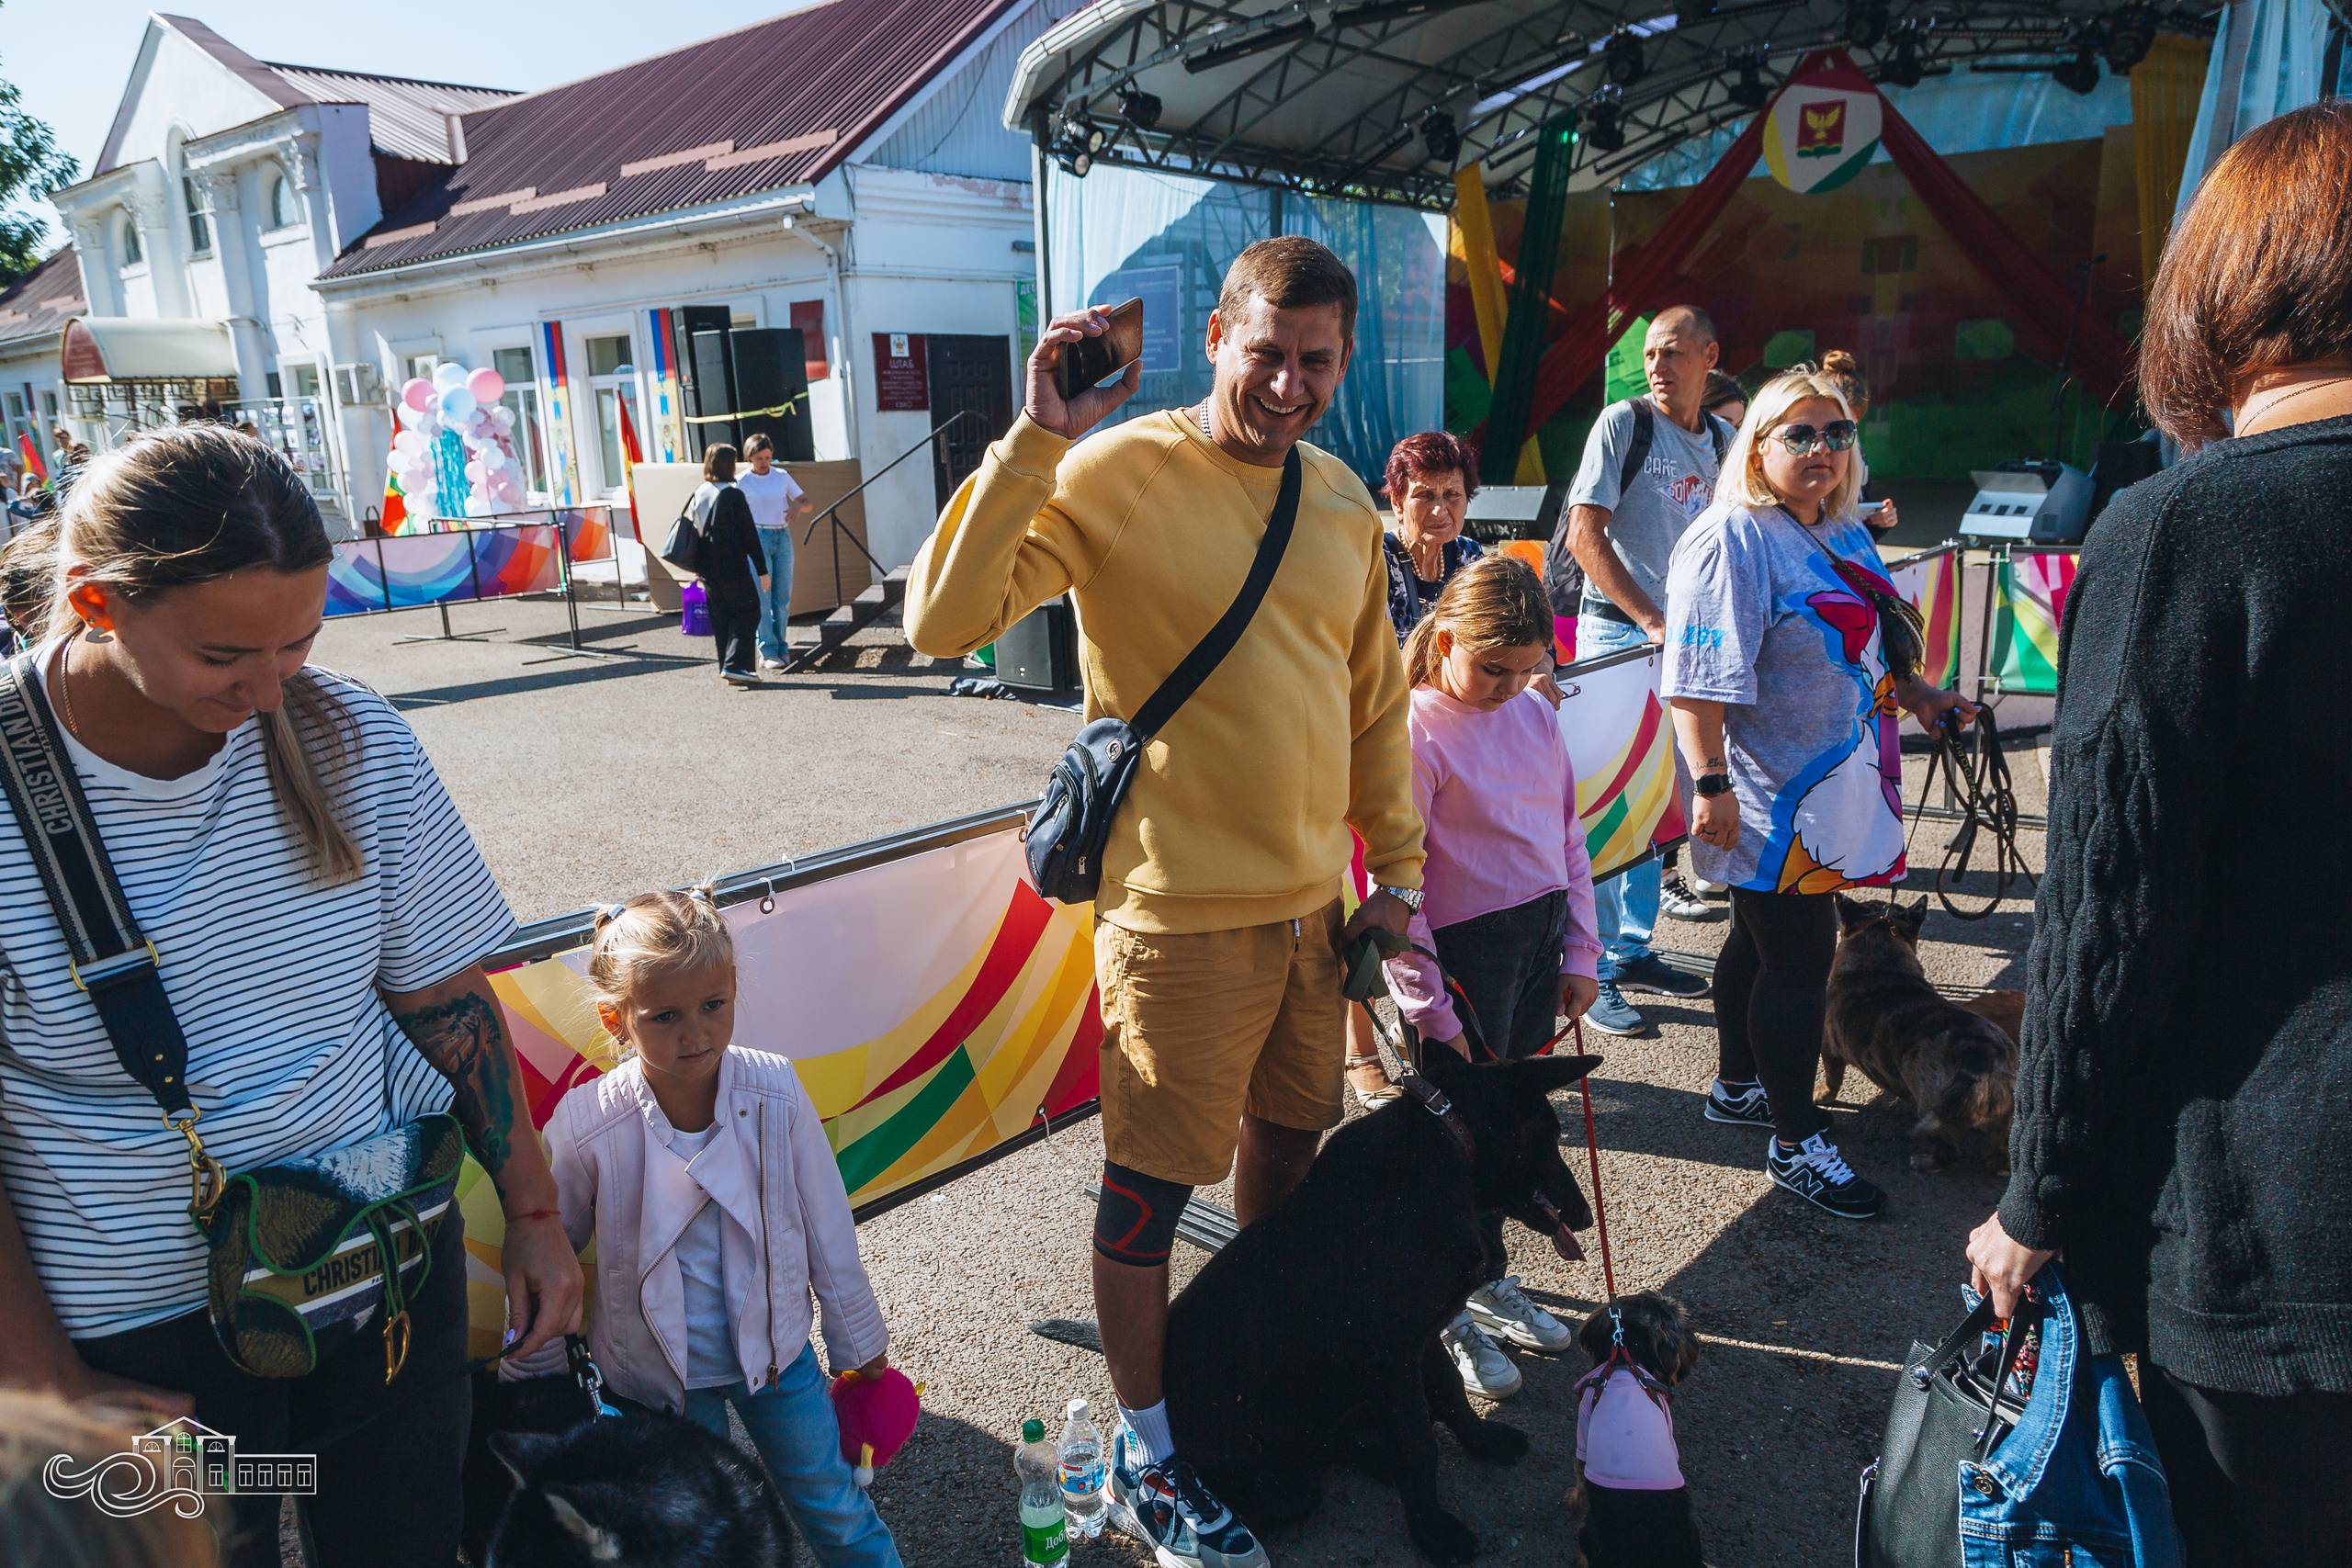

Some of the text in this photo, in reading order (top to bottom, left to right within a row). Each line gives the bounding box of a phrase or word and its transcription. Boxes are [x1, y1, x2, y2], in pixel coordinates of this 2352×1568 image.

[889, 359, 914, 369] ШТАБ
[1644, 456, 1678, 478] CARE
[2, 716, 74, 835] CHRISTIAN
